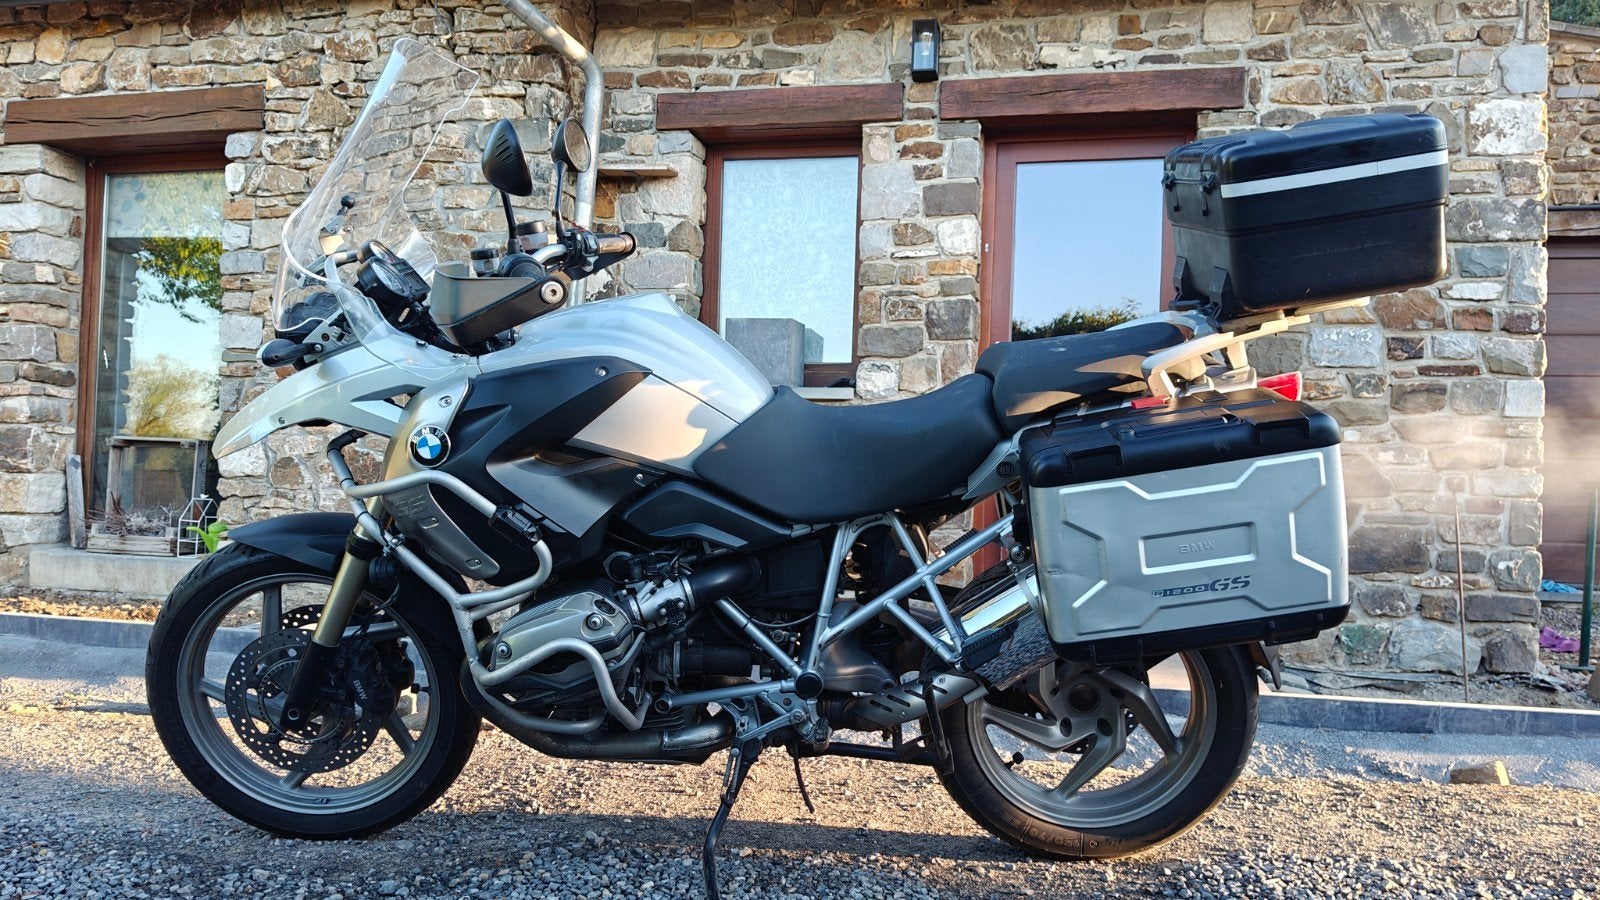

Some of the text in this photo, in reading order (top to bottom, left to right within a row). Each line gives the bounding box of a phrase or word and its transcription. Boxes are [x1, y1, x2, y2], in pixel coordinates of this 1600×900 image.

[412, 427, 443, 443] BMW
[1179, 540, 1216, 554] BMW
[352, 679, 368, 700] BMW
